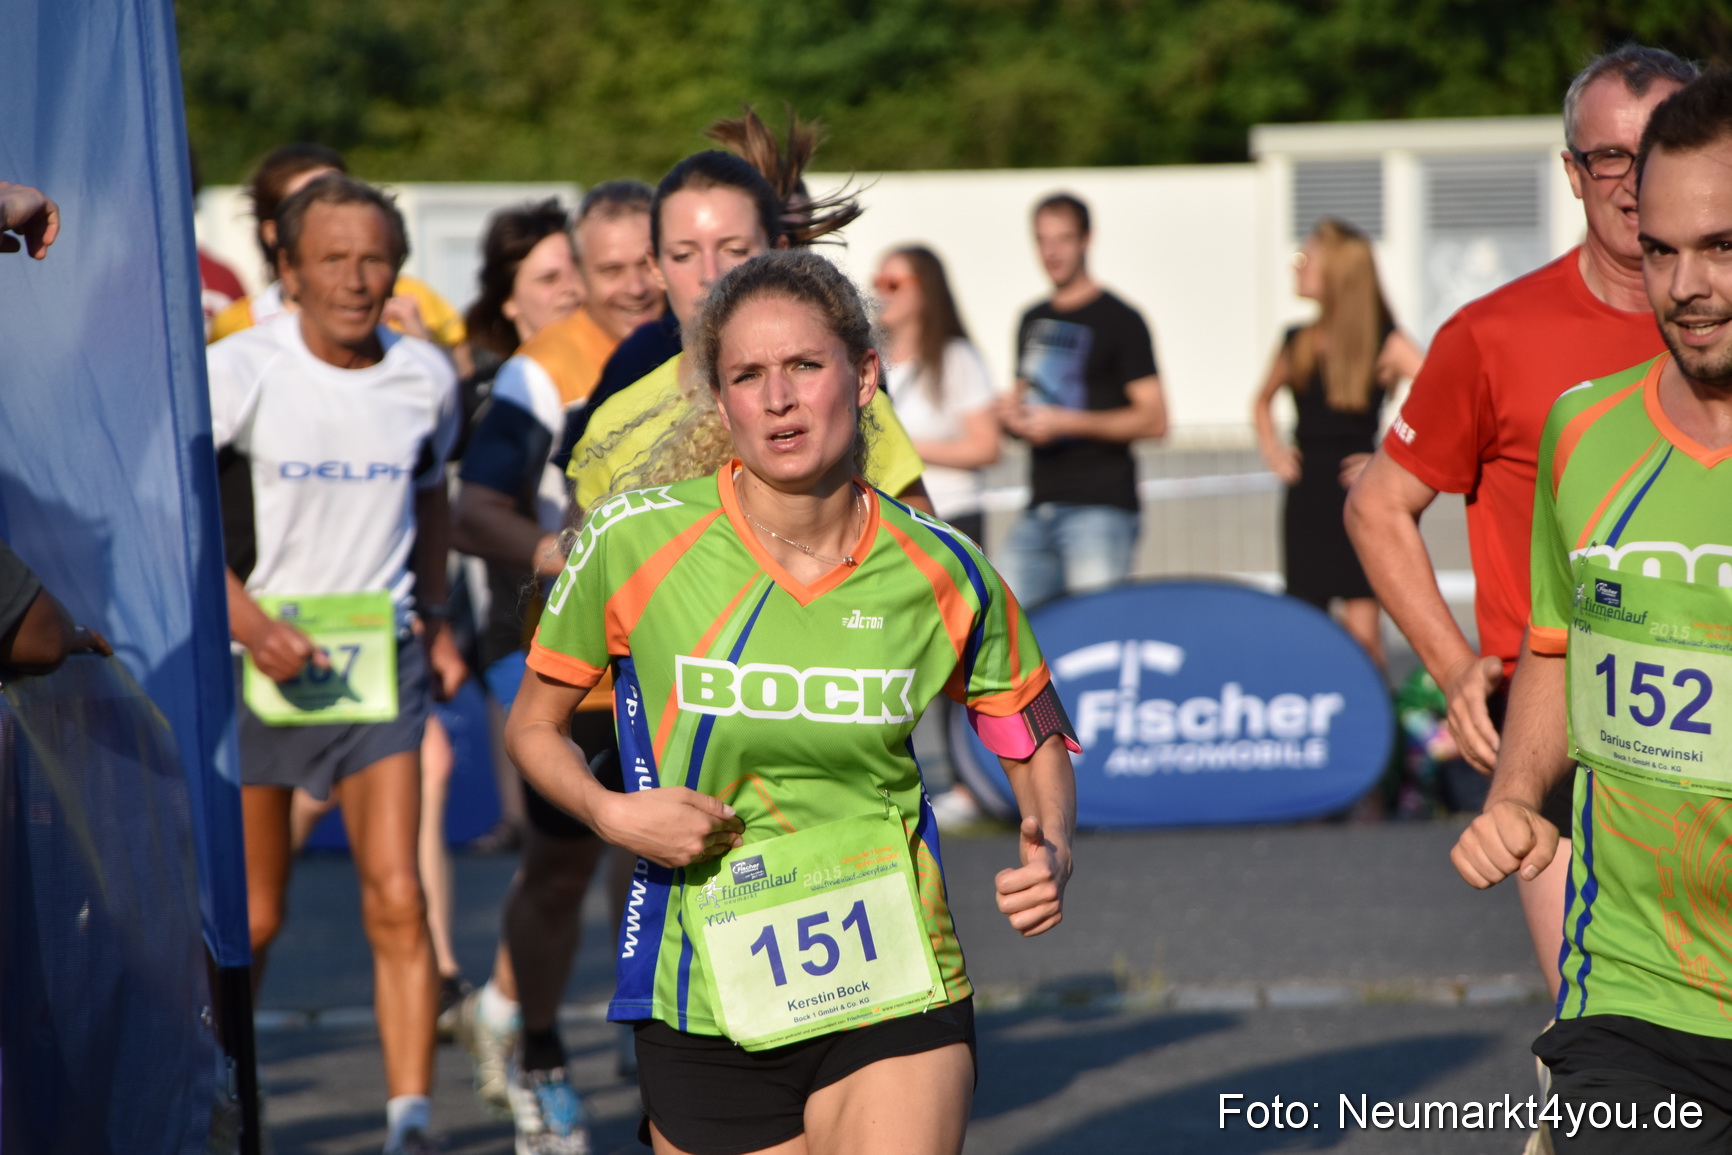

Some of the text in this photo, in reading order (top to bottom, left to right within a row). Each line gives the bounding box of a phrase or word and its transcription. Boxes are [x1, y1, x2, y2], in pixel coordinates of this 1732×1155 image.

[547, 485, 684, 616] BOCK
[1585, 597, 1648, 624] firmenlauf
[1649, 622, 1691, 639] 2015
[675, 654, 916, 724] BOCK
[1596, 653, 1713, 735] 152
[1073, 681, 1346, 750] Fischer
[1105, 738, 1330, 778] AUTOMOBILE
[1600, 729, 1703, 763] Darius Czerwinski
[1613, 751, 1627, 761] Bock
[1632, 757, 1651, 767] GmbH
[1651, 761, 1657, 769] &
[1658, 762, 1669, 771] Co.
[1671, 763, 1682, 773] KG
[722, 867, 797, 900] firmenlauf
[733, 862, 760, 874] Fischer
[803, 865, 842, 887] 2015
[724, 893, 758, 905] neumarkt
[750, 900, 878, 987] 151
[787, 980, 871, 1012] Kerstin Bock
[793, 1014, 811, 1023] Bock
[818, 1007, 839, 1017] GmbH
[846, 1001, 858, 1009] Co.
[859, 997, 870, 1005] KG
